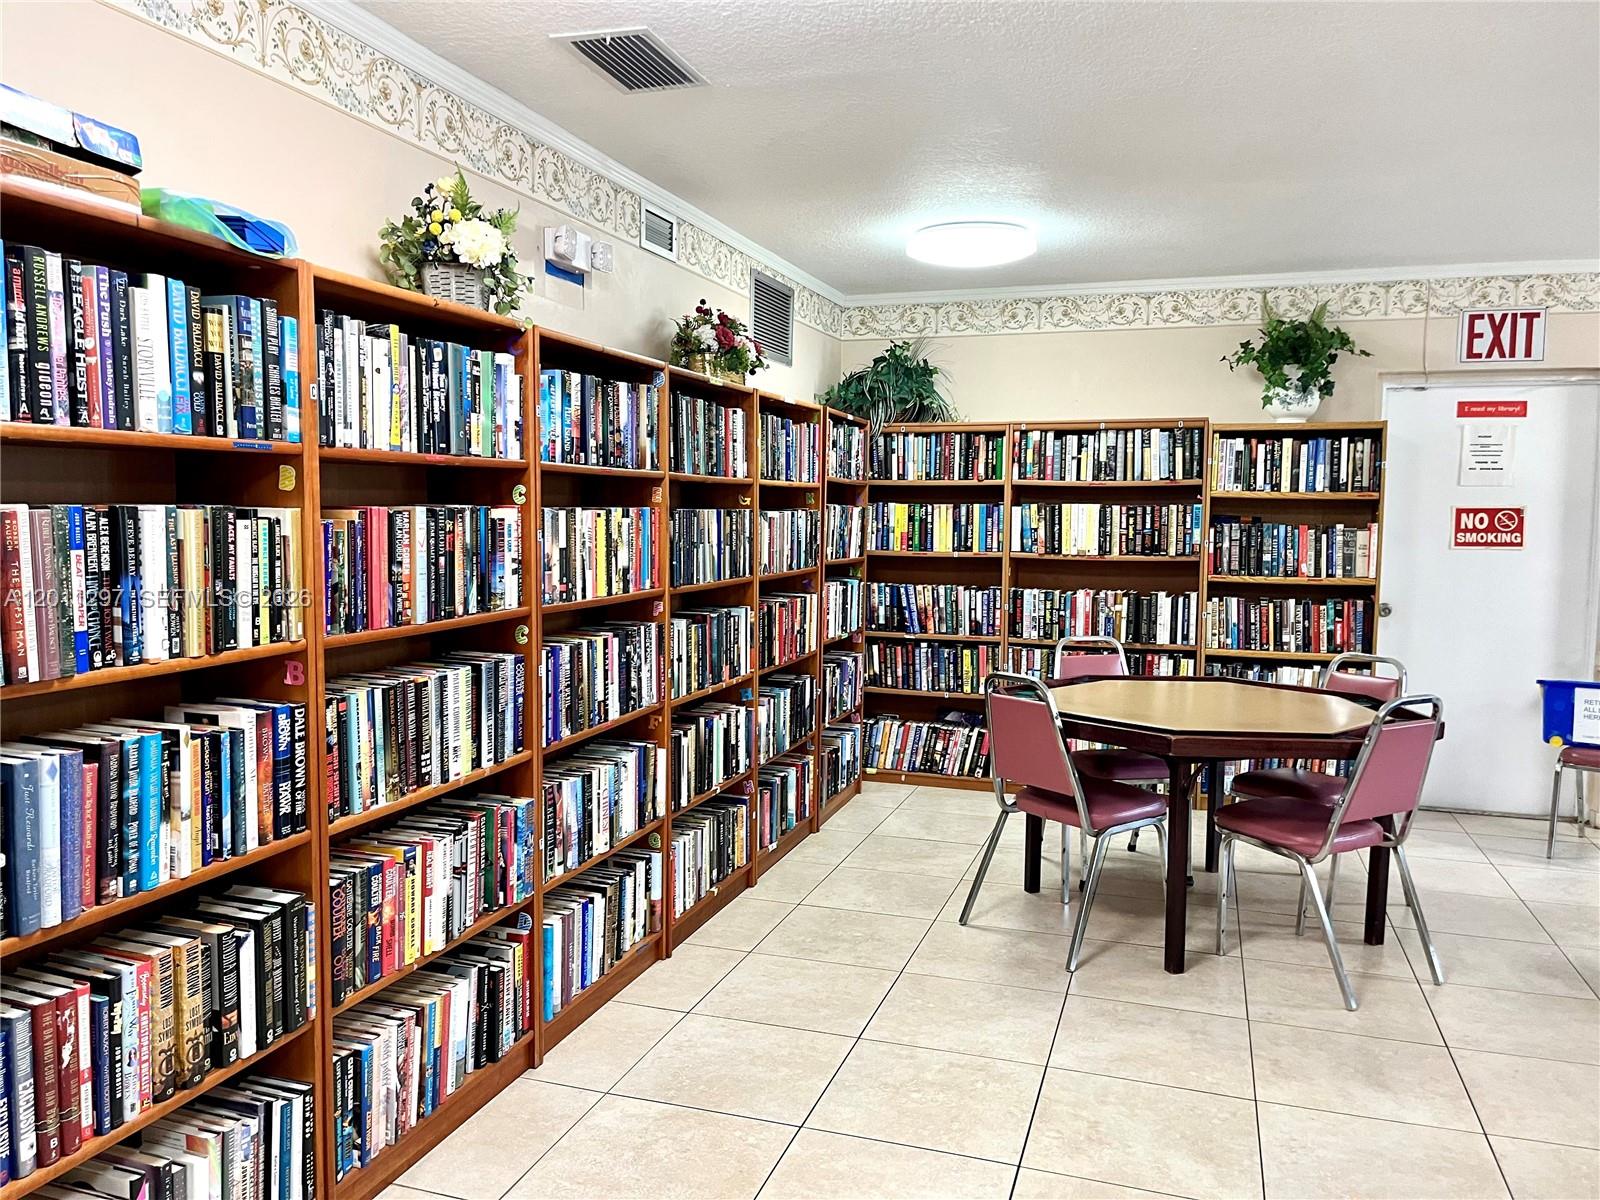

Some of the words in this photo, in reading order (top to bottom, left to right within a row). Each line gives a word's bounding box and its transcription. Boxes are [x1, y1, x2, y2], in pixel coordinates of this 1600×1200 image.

[33, 256, 46, 299] RUSSELL
[100, 272, 110, 302] The
[117, 278, 126, 297] The
[172, 284, 185, 323] DAVID
[190, 290, 201, 319] DAVID
[35, 304, 49, 351] ANDREWS
[72, 294, 86, 350] EAGLE
[100, 302, 111, 337] Push
[266, 307, 278, 336] SHADOW
[192, 322, 203, 367] BALDACCI
[268, 337, 280, 356] PLAY
[1466, 312, 1541, 360] EXIT
[105, 358, 114, 388] Ashley
[138, 338, 156, 400] STORYVILLE
[174, 328, 186, 391] BALDACCI
[214, 354, 224, 380] DAVID
[35, 362, 52, 406] gideon
[75, 352, 88, 401] HEIST
[269, 364, 280, 395] CHARLES
[108, 388, 116, 424] Audrain
[122, 384, 130, 409] Bailey
[176, 394, 187, 415] FIX
[215, 382, 225, 423] BALDACCI
[256, 377, 264, 426] SUSPECT
[270, 396, 281, 423] BAXTER
[513, 485, 527, 505] C
[42, 516, 51, 539] REBEL
[86, 511, 96, 531] ALAN
[100, 518, 110, 535] ALEX
[168, 518, 176, 532] THE
[228, 512, 235, 523] MY
[1460, 513, 1489, 529] NO
[5, 520, 13, 551] BAUSCH
[127, 520, 136, 546] STEVE
[170, 533, 178, 551] LAST
[1456, 532, 1521, 544] SMOKING
[43, 544, 52, 580] POWERS
[88, 534, 99, 573] BRENNERT
[101, 536, 111, 571] BERENSON
[128, 548, 137, 577] BERRY
[229, 544, 235, 554] MY
[402, 547, 410, 575] COBEN
[170, 552, 180, 584] ILLUSION
[16, 630, 24, 656] MAN
[88, 610, 101, 650] CHANCE
[515, 624, 529, 645] C
[284, 660, 304, 686] B
[422, 687, 430, 717] PATRICIA
[278, 714, 288, 752] BROWN
[295, 708, 306, 740] DALE
[129, 744, 139, 769] BARBARA
[262, 728, 270, 762] BROWN
[110, 754, 119, 780] BARBARA
[295, 741, 307, 789] BROWN
[23, 784, 34, 805] Just
[129, 788, 139, 816] BRADFORD
[262, 782, 270, 815] BATTLE
[280, 782, 289, 816] HAWK
[110, 800, 119, 830] BRADFORD
[547, 807, 555, 826] KEN
[25, 808, 35, 852] Rewards
[129, 821, 139, 840] POWER
[129, 853, 139, 874] WOMAN
[371, 875, 380, 907] COULTER
[385, 868, 394, 899] COULTER
[333, 889, 344, 942] COULTER
[159, 954, 172, 975] DAN
[186, 945, 199, 965] DAN
[223, 932, 237, 971] SANDRA
[372, 946, 380, 962] FIRE
[140, 972, 149, 1006] Boomsday
[160, 975, 173, 1010] BROWN
[187, 964, 200, 999] BROWN
[224, 971, 238, 1008] BROWN
[42, 1011, 52, 1026] THE
[16, 1020, 31, 1048] Sandra
[43, 1028, 53, 1040] DA
[141, 1011, 149, 1060] CHRISTOPHER
[16, 1050, 33, 1078] Brown
[44, 1041, 53, 1063] VINCI
[44, 1066, 55, 1084] CODE
[45, 1091, 55, 1107] DAN
